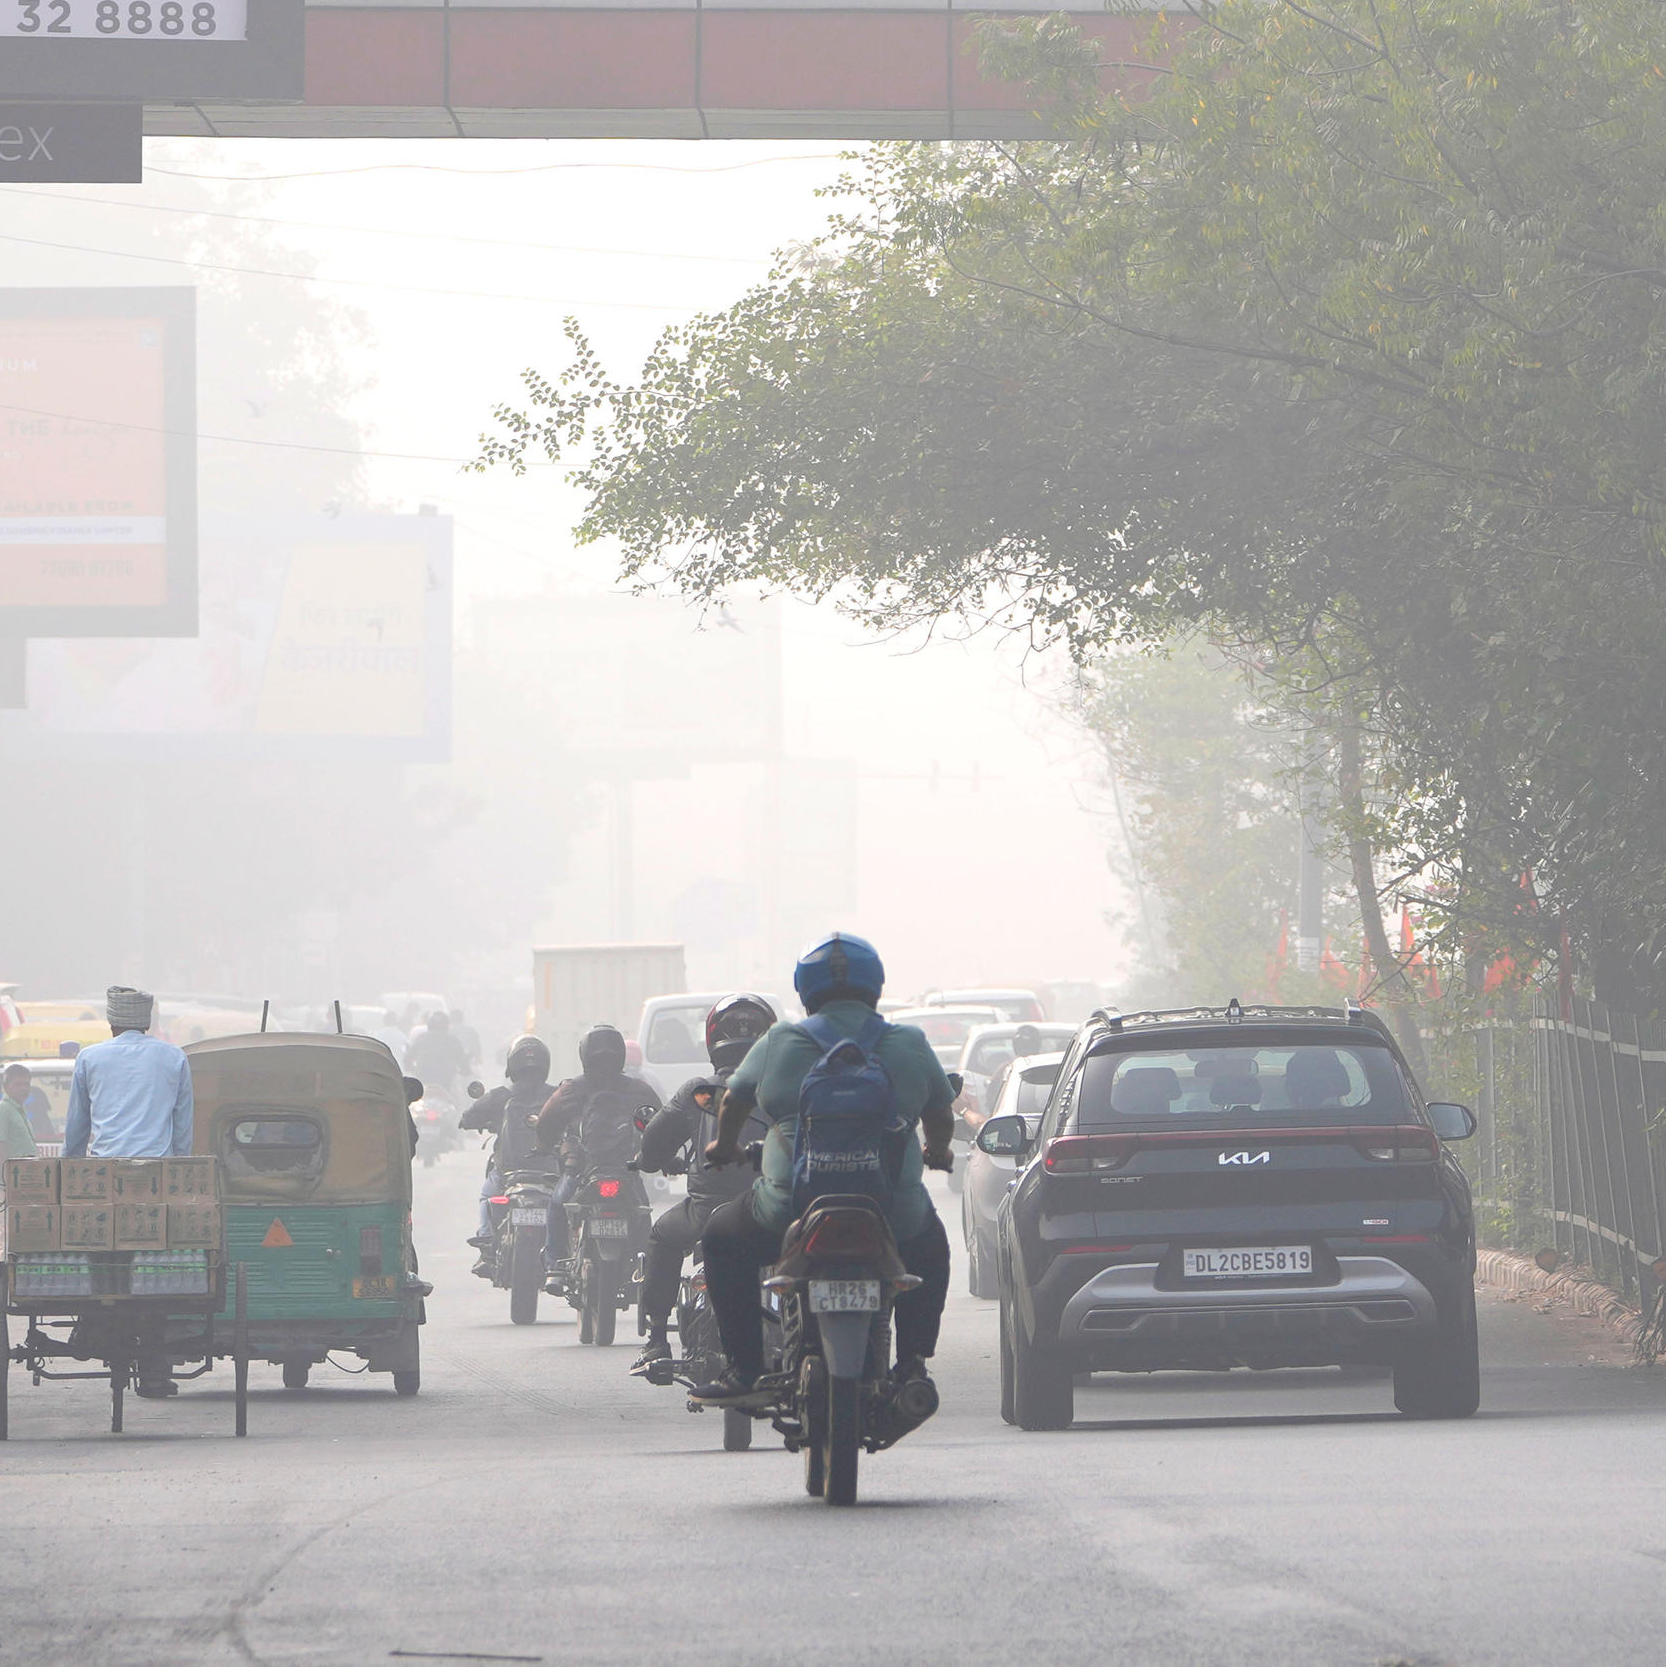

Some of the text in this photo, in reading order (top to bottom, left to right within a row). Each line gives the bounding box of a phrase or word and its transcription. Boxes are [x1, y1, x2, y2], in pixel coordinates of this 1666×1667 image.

[95, 0, 217, 36] 8888
[810, 1149, 880, 1162] MERICA
[1195, 1250, 1311, 1273] DL2CBE5819
[828, 1281, 868, 1296] HR26
